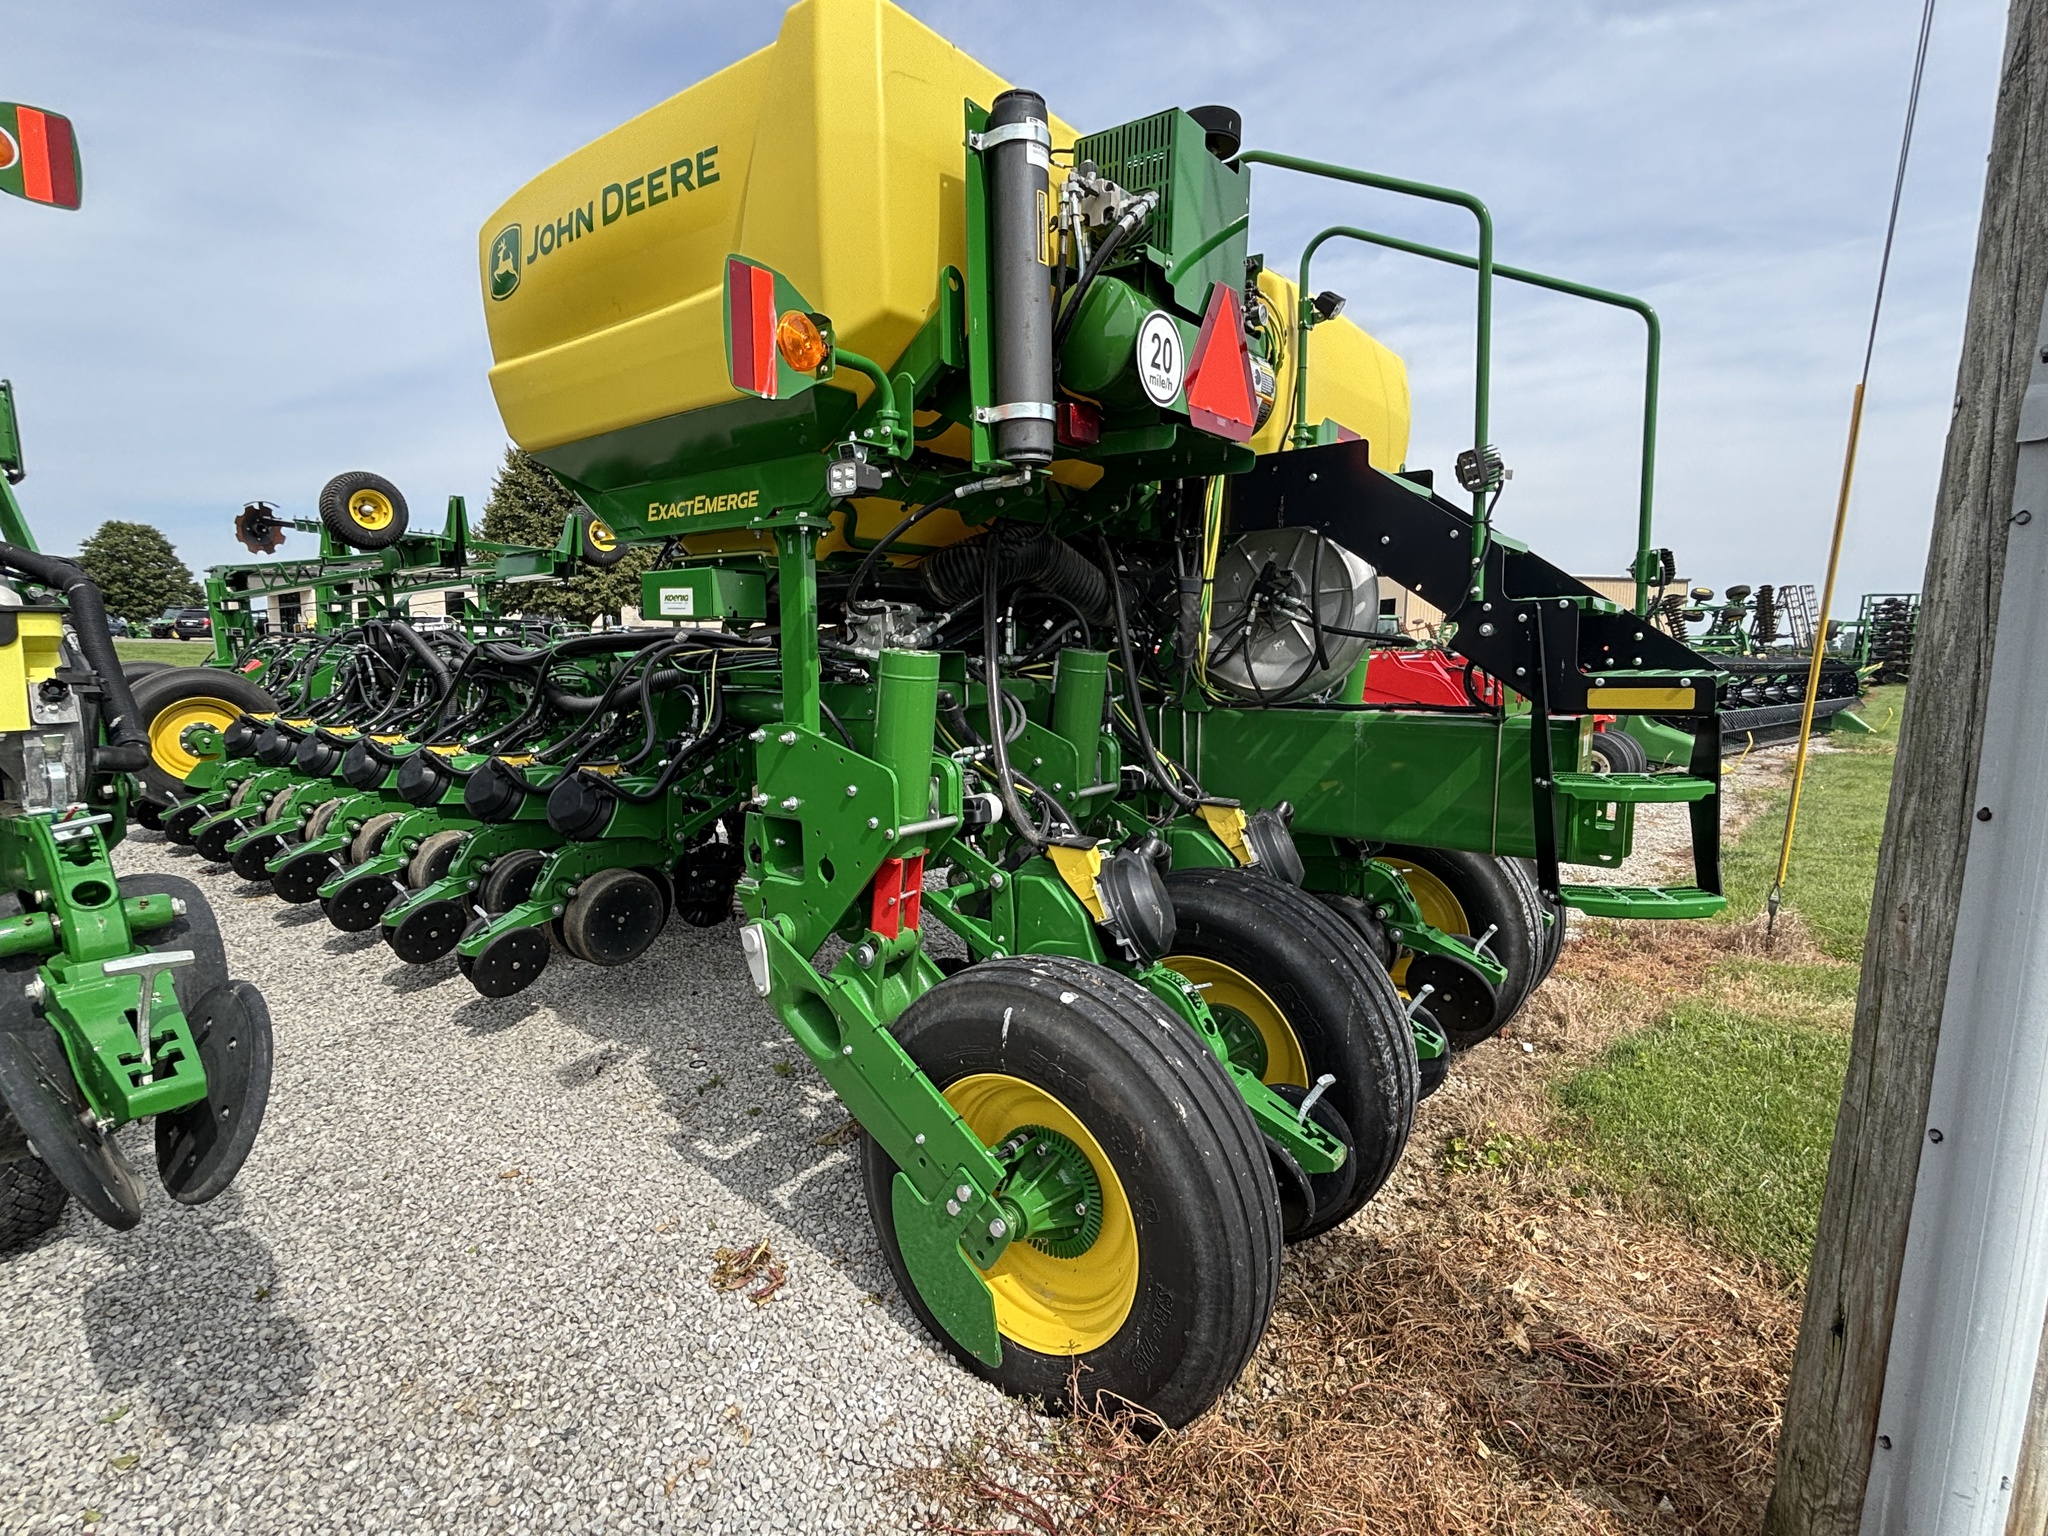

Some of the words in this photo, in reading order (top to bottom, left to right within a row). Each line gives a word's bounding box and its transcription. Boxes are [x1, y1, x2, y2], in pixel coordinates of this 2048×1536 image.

[526, 200, 594, 265] JOHN
[602, 145, 720, 227] DEERE
[1151, 333, 1173, 374] 20
[1149, 374, 1173, 392] mile/h
[647, 490, 760, 522] EXACTEMERGE
